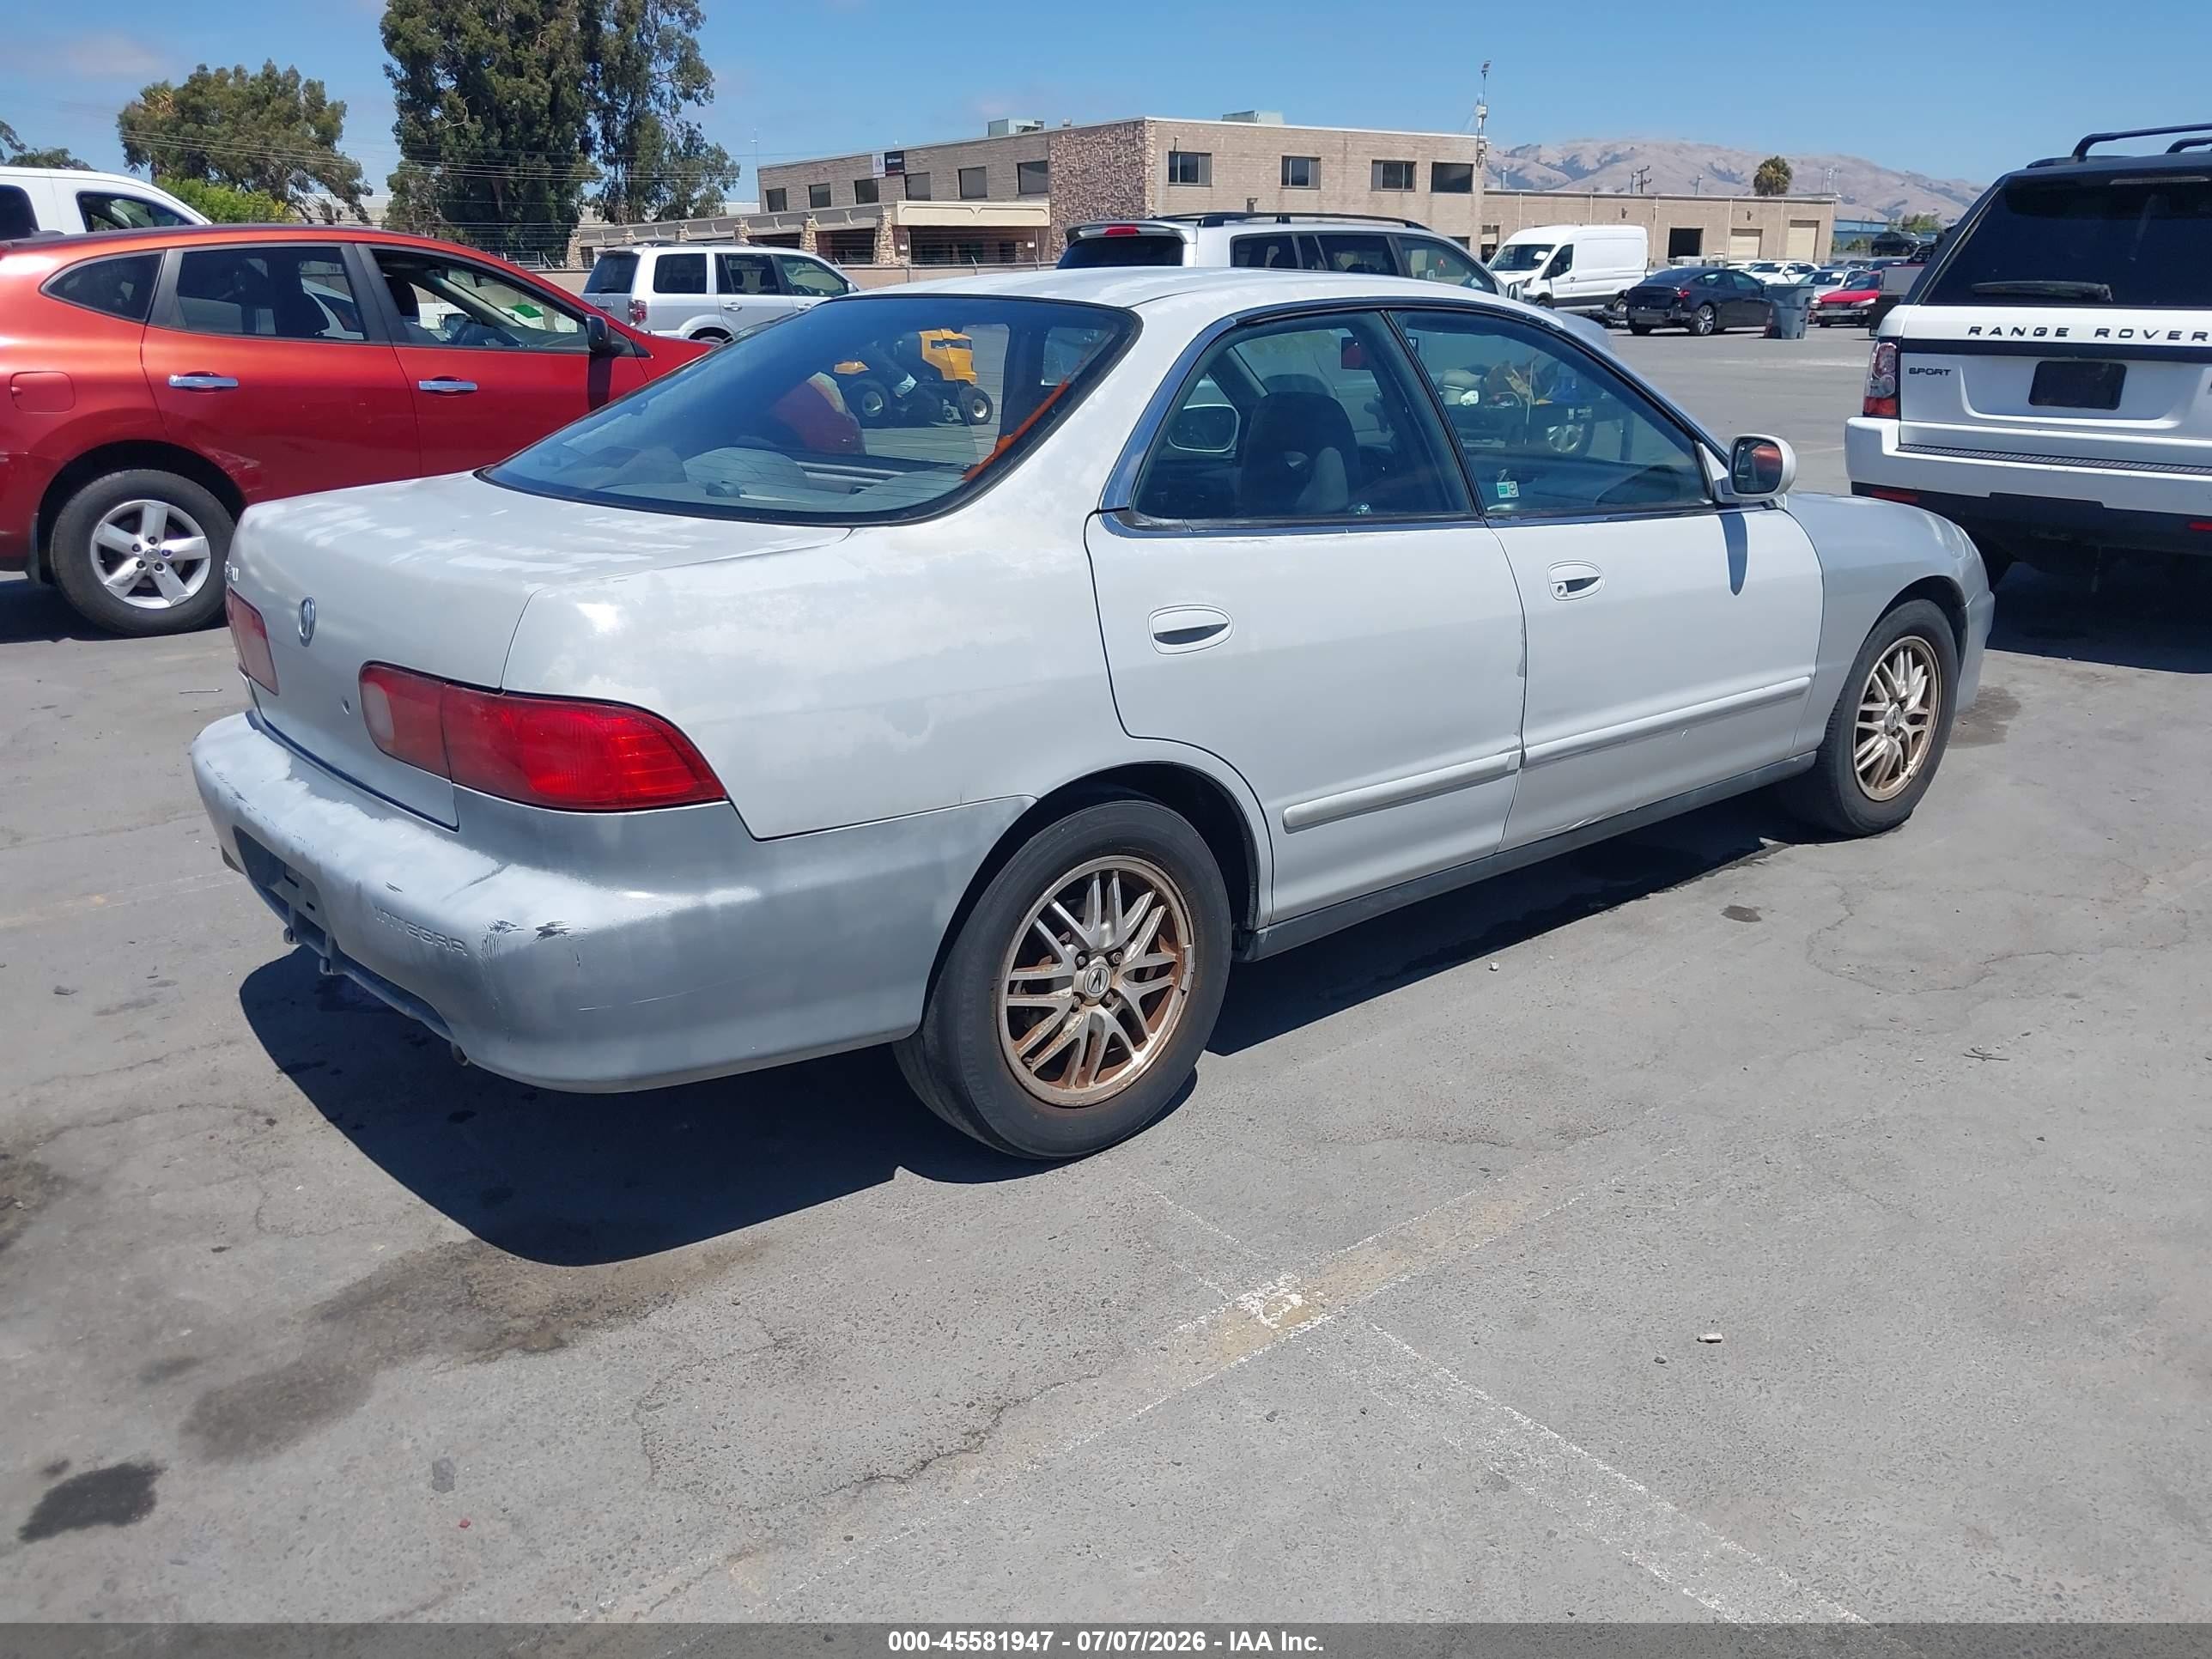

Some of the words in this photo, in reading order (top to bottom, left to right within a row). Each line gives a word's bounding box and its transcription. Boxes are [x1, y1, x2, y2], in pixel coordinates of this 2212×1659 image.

[1967, 326, 2070, 337] RANGE
[2094, 328, 2209, 342] ROVER
[1909, 368, 1951, 376] SPORT
